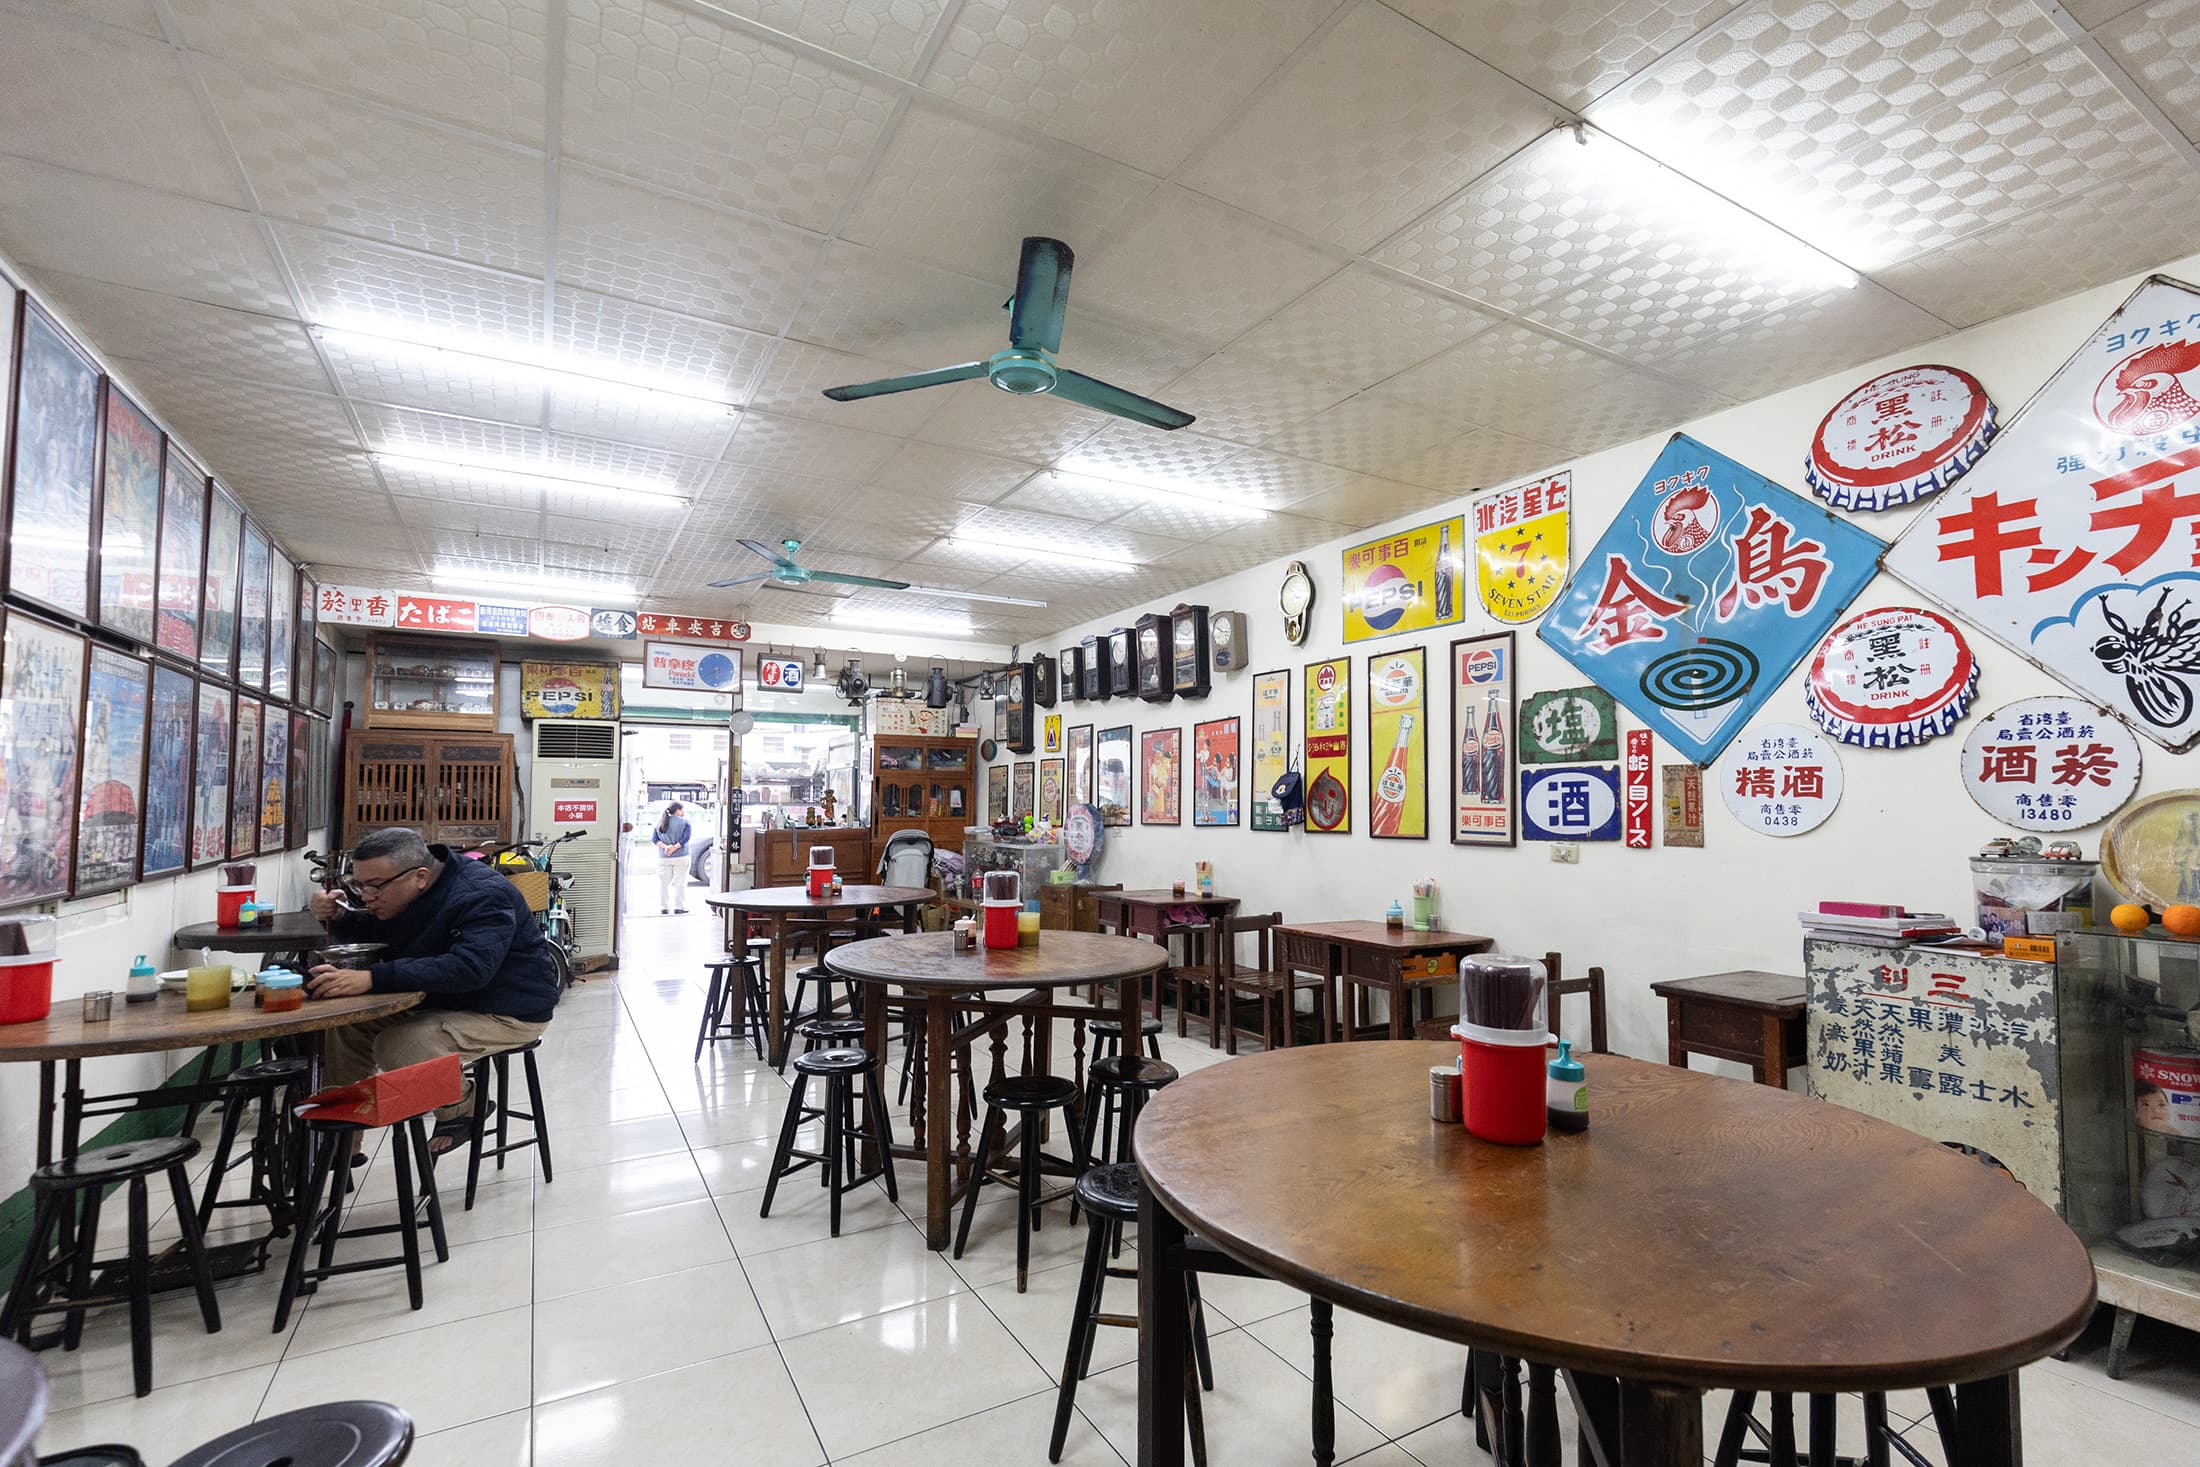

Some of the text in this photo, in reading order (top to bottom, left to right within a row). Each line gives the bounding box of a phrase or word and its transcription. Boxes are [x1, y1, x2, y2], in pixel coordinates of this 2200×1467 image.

[1871, 445, 1917, 463] DRINK
[1654, 466, 1709, 494] ヨクキク
[1938, 447, 2200, 599] キンチ
[1510, 541, 1533, 579] 7
[1489, 575, 1556, 609] SEVEN STAR
[399, 601, 474, 625] たばこ
[641, 615, 723, 636] 吉安車站
[1857, 622, 1868, 631] HE
[1871, 618, 1896, 628] SUNG
[785, 668, 800, 682] 酒
[1468, 661, 1497, 673] PEPSI
[1871, 690, 1911, 701] DRINK
[1545, 701, 1588, 746] 塩
[1547, 780, 1590, 827] 酒
[1628, 754, 1649, 846] 蛇ノ目ソース
[1764, 815, 1799, 826] 0438
[2020, 807, 2072, 822] 13480
